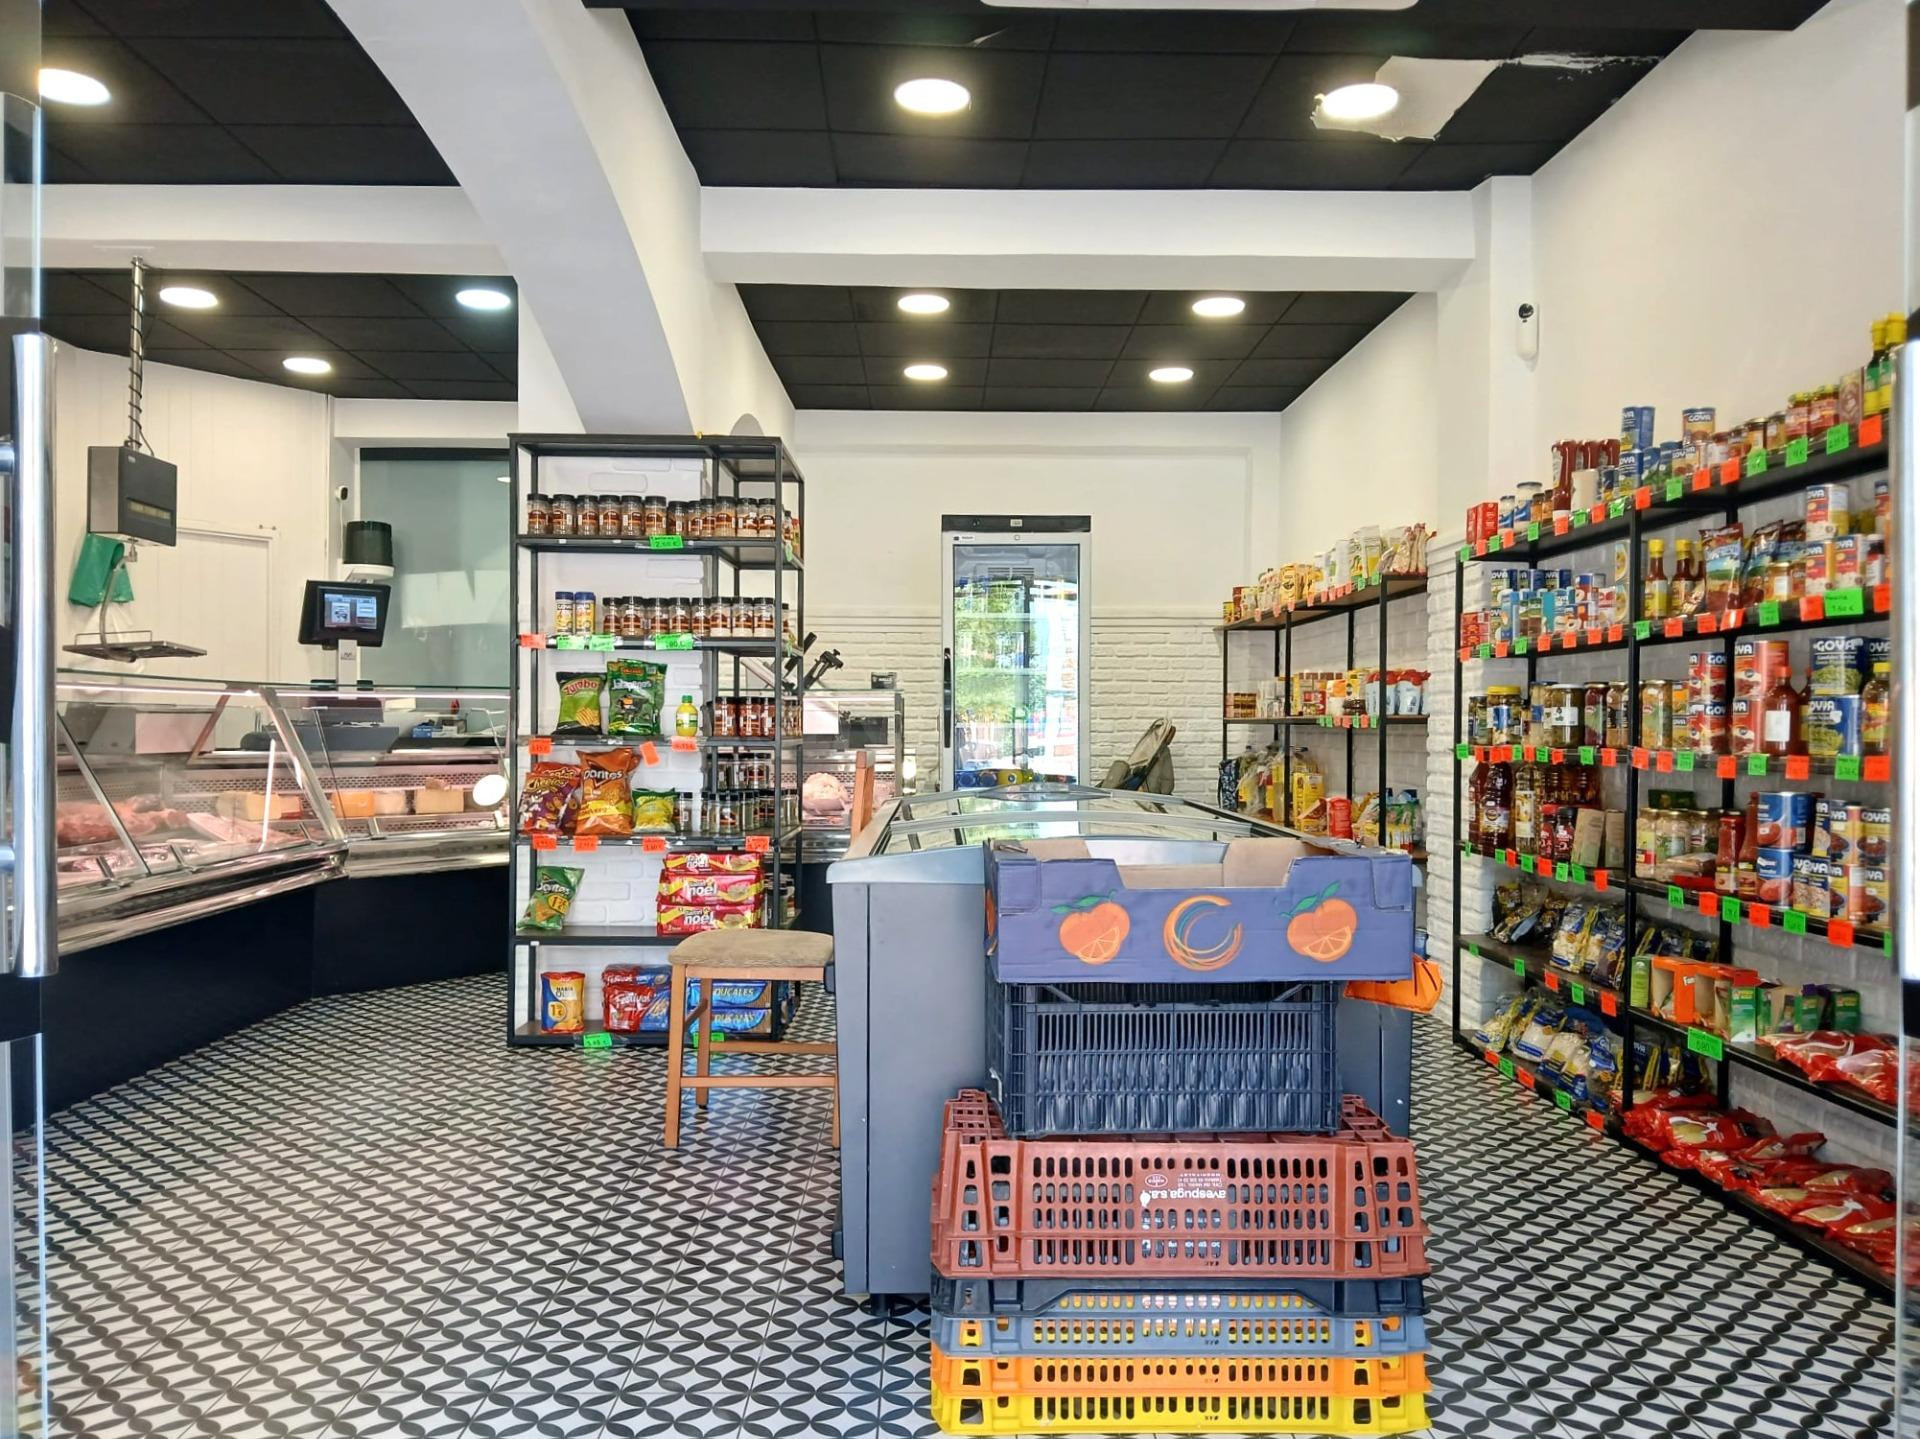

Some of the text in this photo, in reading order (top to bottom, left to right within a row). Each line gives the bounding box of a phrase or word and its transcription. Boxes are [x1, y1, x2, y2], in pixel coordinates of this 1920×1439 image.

[1807, 489, 1825, 498] OYA
[1491, 571, 1508, 579] OYA
[1816, 640, 1855, 652] GOYA
[1707, 655, 1725, 664] GO
[1705, 706, 1725, 715] GO
[583, 769, 623, 781] Doritos
[688, 883, 717, 895] noel
[684, 911, 714, 926] noel
[715, 988, 754, 996] DUCALES
